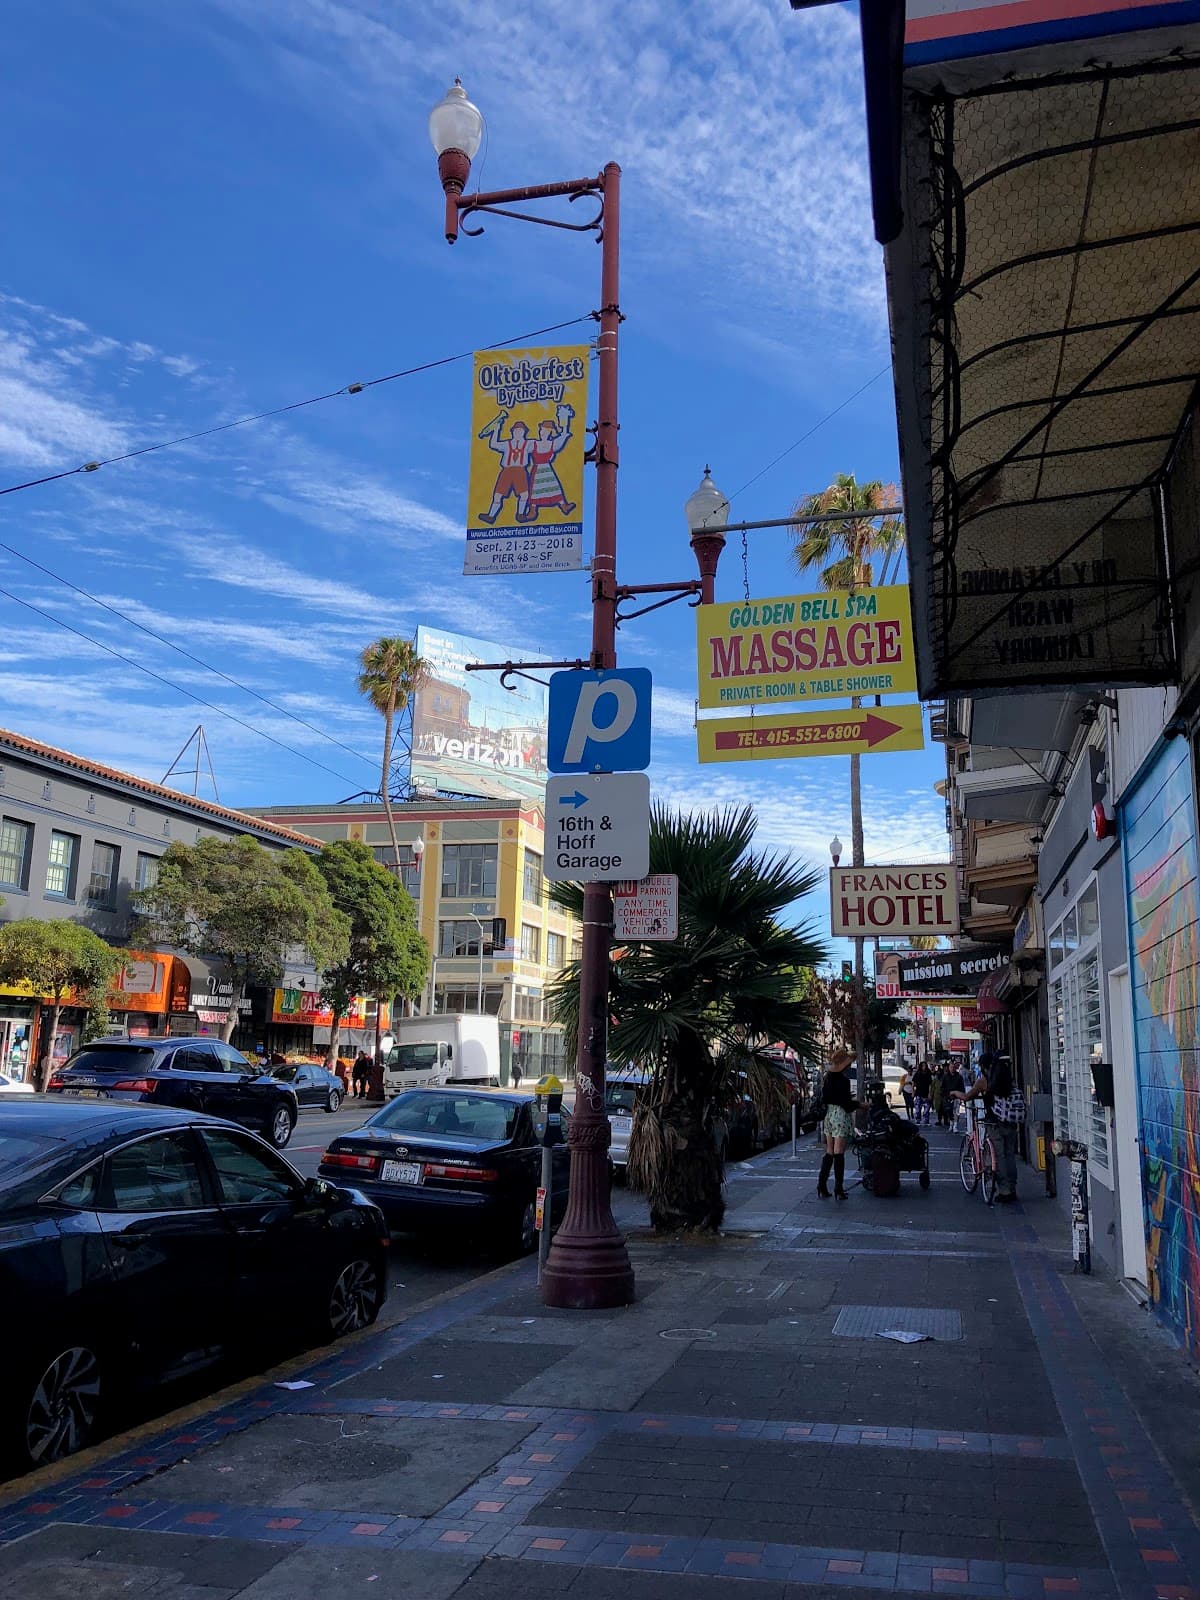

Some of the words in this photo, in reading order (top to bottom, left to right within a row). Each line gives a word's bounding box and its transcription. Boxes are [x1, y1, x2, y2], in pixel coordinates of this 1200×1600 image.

[480, 359, 583, 387] Oktoberfest
[499, 387, 514, 406] By
[515, 386, 537, 401] the
[538, 384, 563, 402] Bay
[475, 542, 502, 553] Sept.
[492, 553, 514, 563] PIER
[729, 602, 795, 629] GOLDEN
[800, 599, 840, 622] BELL
[845, 594, 878, 618] SPA
[709, 620, 902, 679] MASSAGE
[720, 684, 764, 701] PRIVATE
[765, 683, 796, 697] ROOM
[799, 681, 807, 695] &
[809, 678, 844, 694] TABLE
[846, 674, 893, 692] SHOWER
[737, 732, 763, 747] TEL:
[766, 725, 861, 743] 415-552-6800
[433, 734, 524, 768] verizon
[558, 816, 594, 831] 16th
[600, 816, 612, 831] &
[557, 834, 596, 850] Hoff
[556, 852, 622, 871] Garage
[617, 880, 634, 894] NO
[640, 877, 673, 886] DOUBLE
[640, 887, 672, 896] PARKING
[840, 872, 948, 892] FRANCES
[617, 908, 674, 917] COMMERCIAL
[624, 899, 643, 907] ANY
[648, 899, 669, 907] TIME
[841, 895, 952, 926] HOTEL
[903, 960, 953, 982] mission
[960, 951, 1010, 975] secrets
